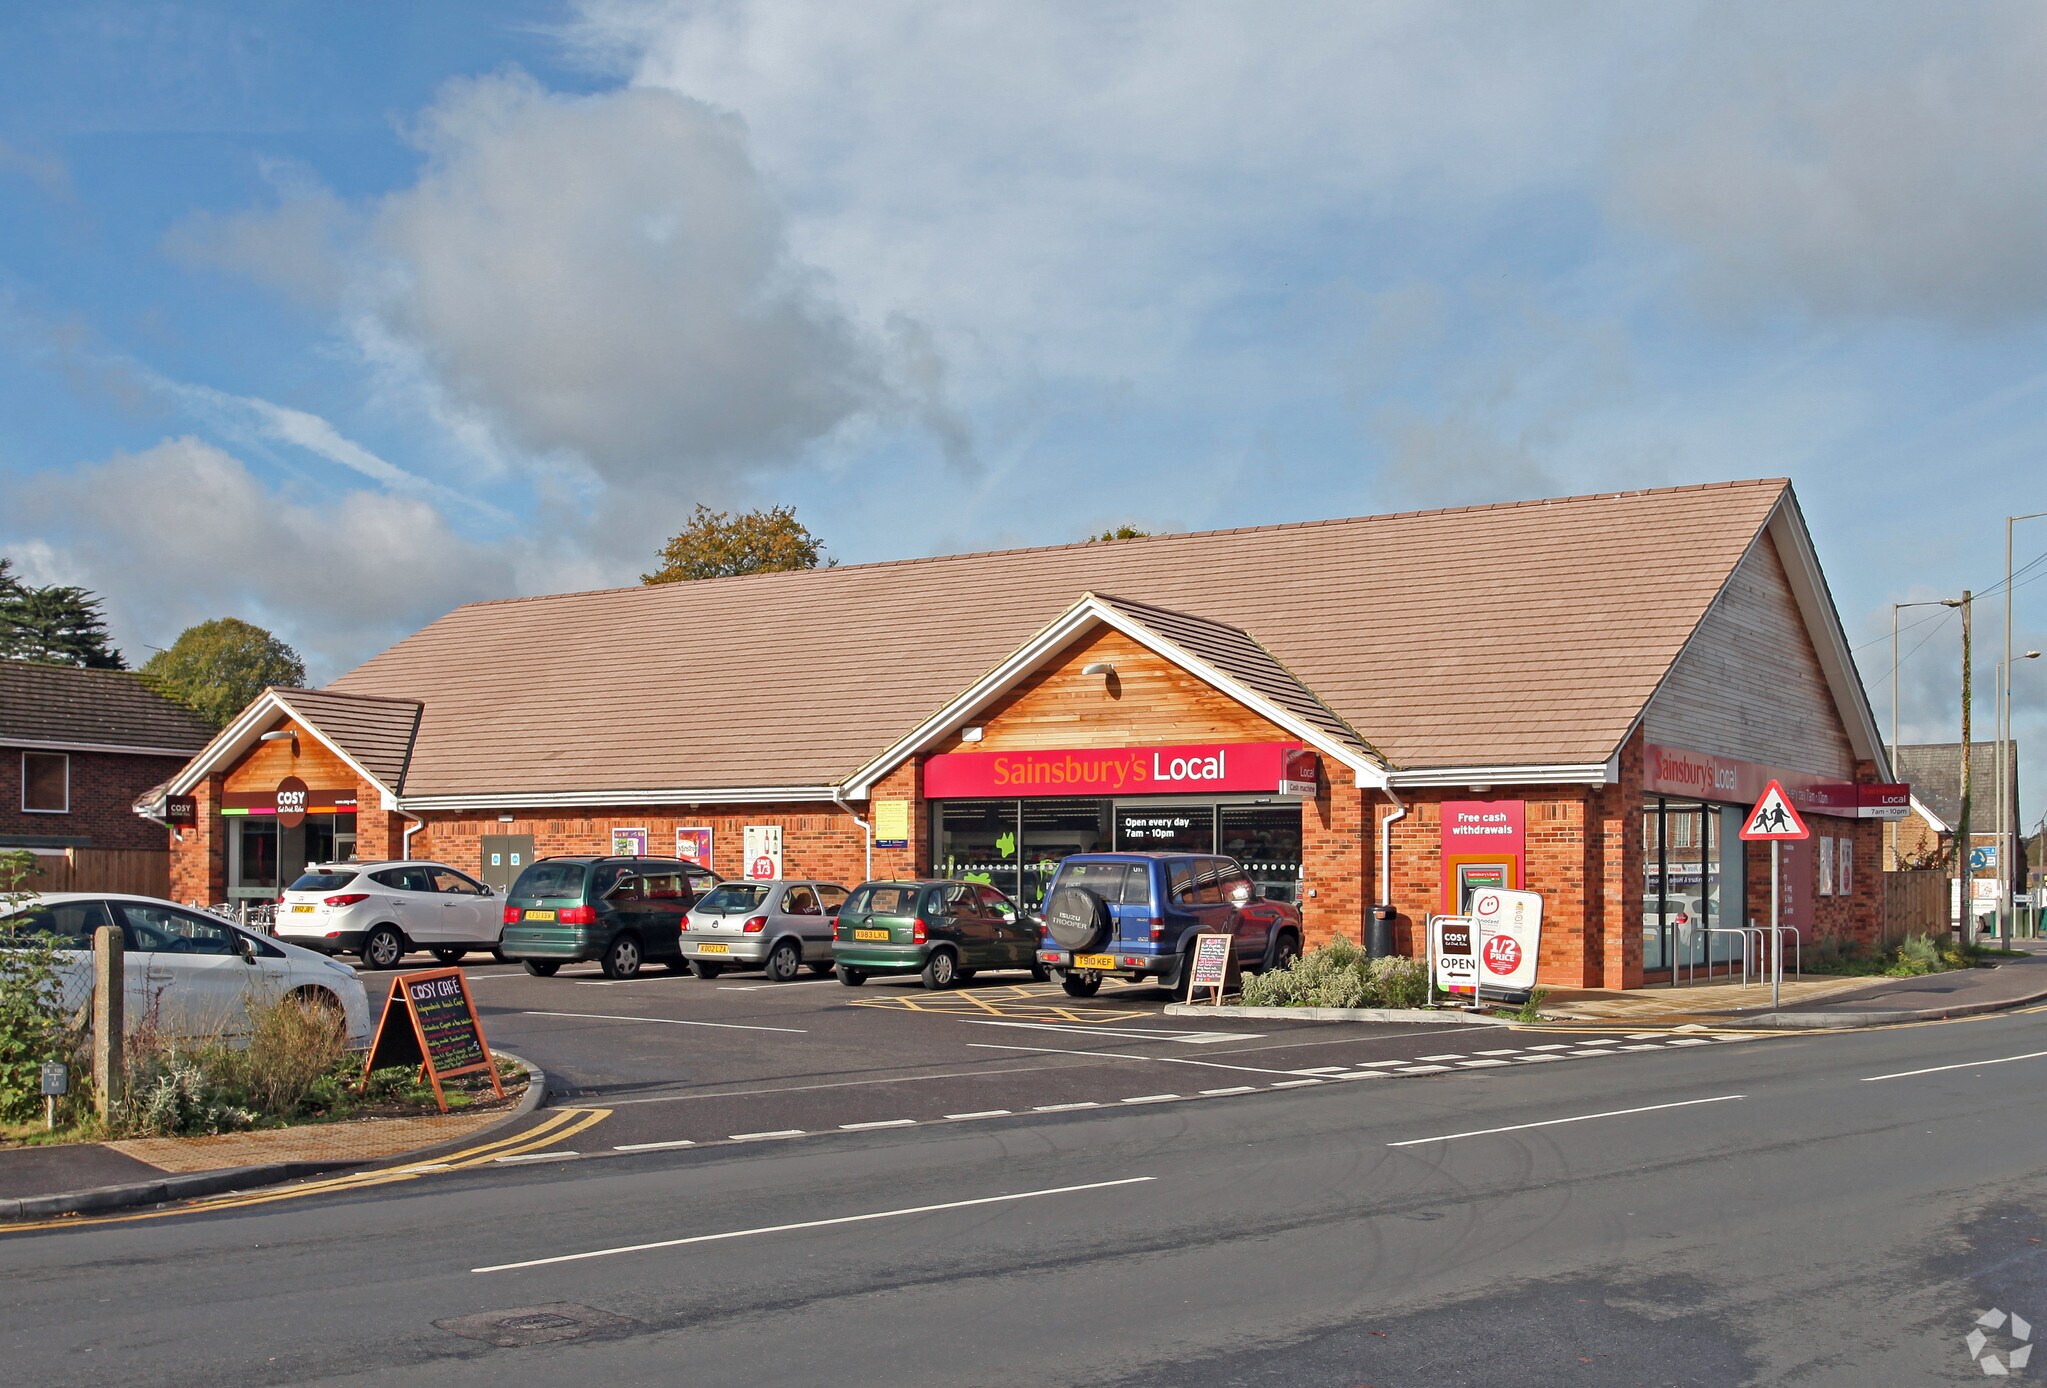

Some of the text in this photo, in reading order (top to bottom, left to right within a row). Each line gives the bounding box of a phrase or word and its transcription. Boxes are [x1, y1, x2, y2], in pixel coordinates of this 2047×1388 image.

[993, 750, 1225, 788] Sainsbury's Local
[1299, 766, 1315, 778] Local
[1655, 751, 1737, 792] Sainsbury's Local
[1289, 783, 1315, 793] Cash machine
[277, 791, 305, 805] COSY
[1882, 795, 1906, 804] Local
[170, 804, 191, 812] COSY
[1125, 817, 1190, 828] Open every day
[1458, 812, 1507, 822] Free cash
[1125, 828, 1144, 838] 7am
[1151, 828, 1175, 839] 10pm
[1452, 824, 1513, 835] withdrawals
[757, 864, 771, 875] 1/3
[1059, 912, 1081, 921] ISUZU
[1052, 917, 1088, 930] TROOPER
[857, 931, 873, 939] X983
[1444, 932, 1467, 942] COSY
[1489, 938, 1516, 955] 1/2
[1079, 957, 1112, 966] T910 KEF
[1489, 952, 1515, 962] PRICE
[1440, 957, 1476, 970] OPEN
[410, 977, 461, 1000] COSY CAFÉ
